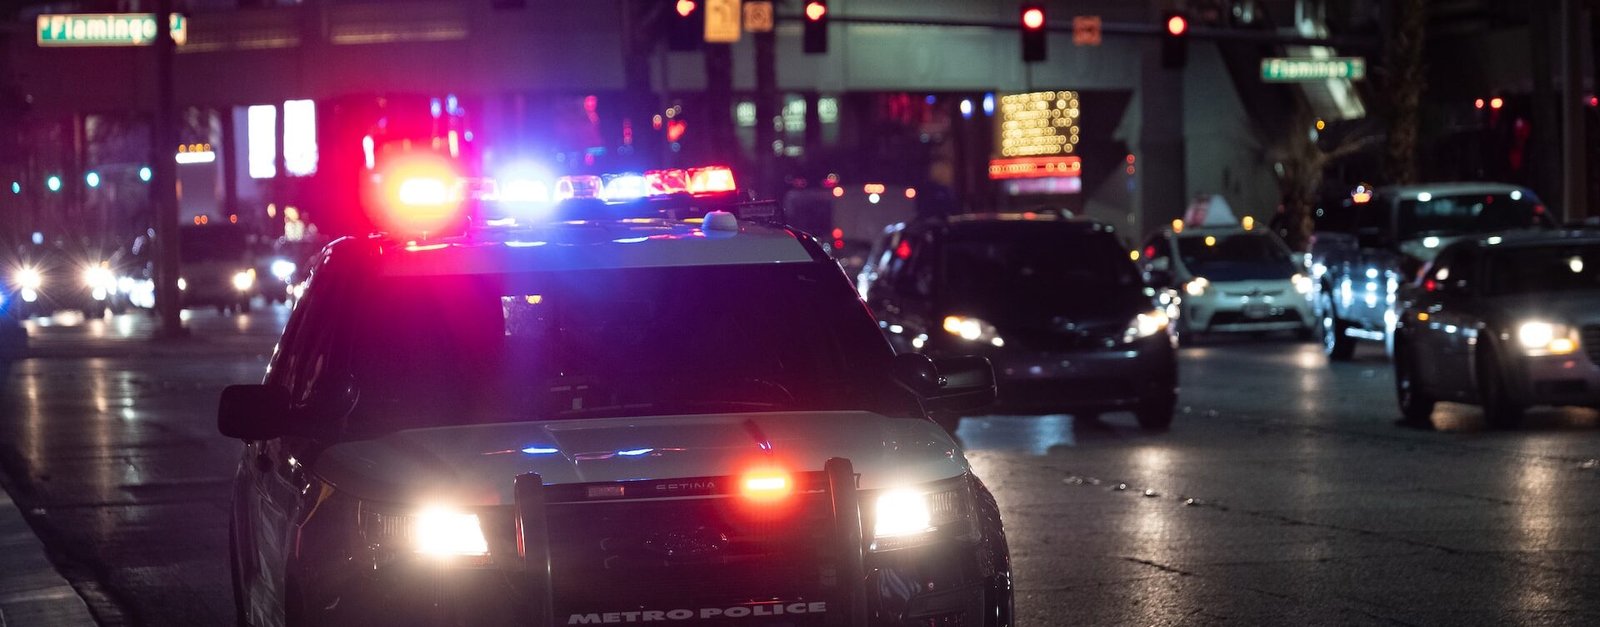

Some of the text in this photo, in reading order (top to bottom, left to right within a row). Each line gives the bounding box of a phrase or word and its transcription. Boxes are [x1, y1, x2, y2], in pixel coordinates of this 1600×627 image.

[51, 15, 157, 44] Flamingo
[1271, 59, 1347, 78] Flamingo
[568, 602, 827, 624] METRO POLICE
